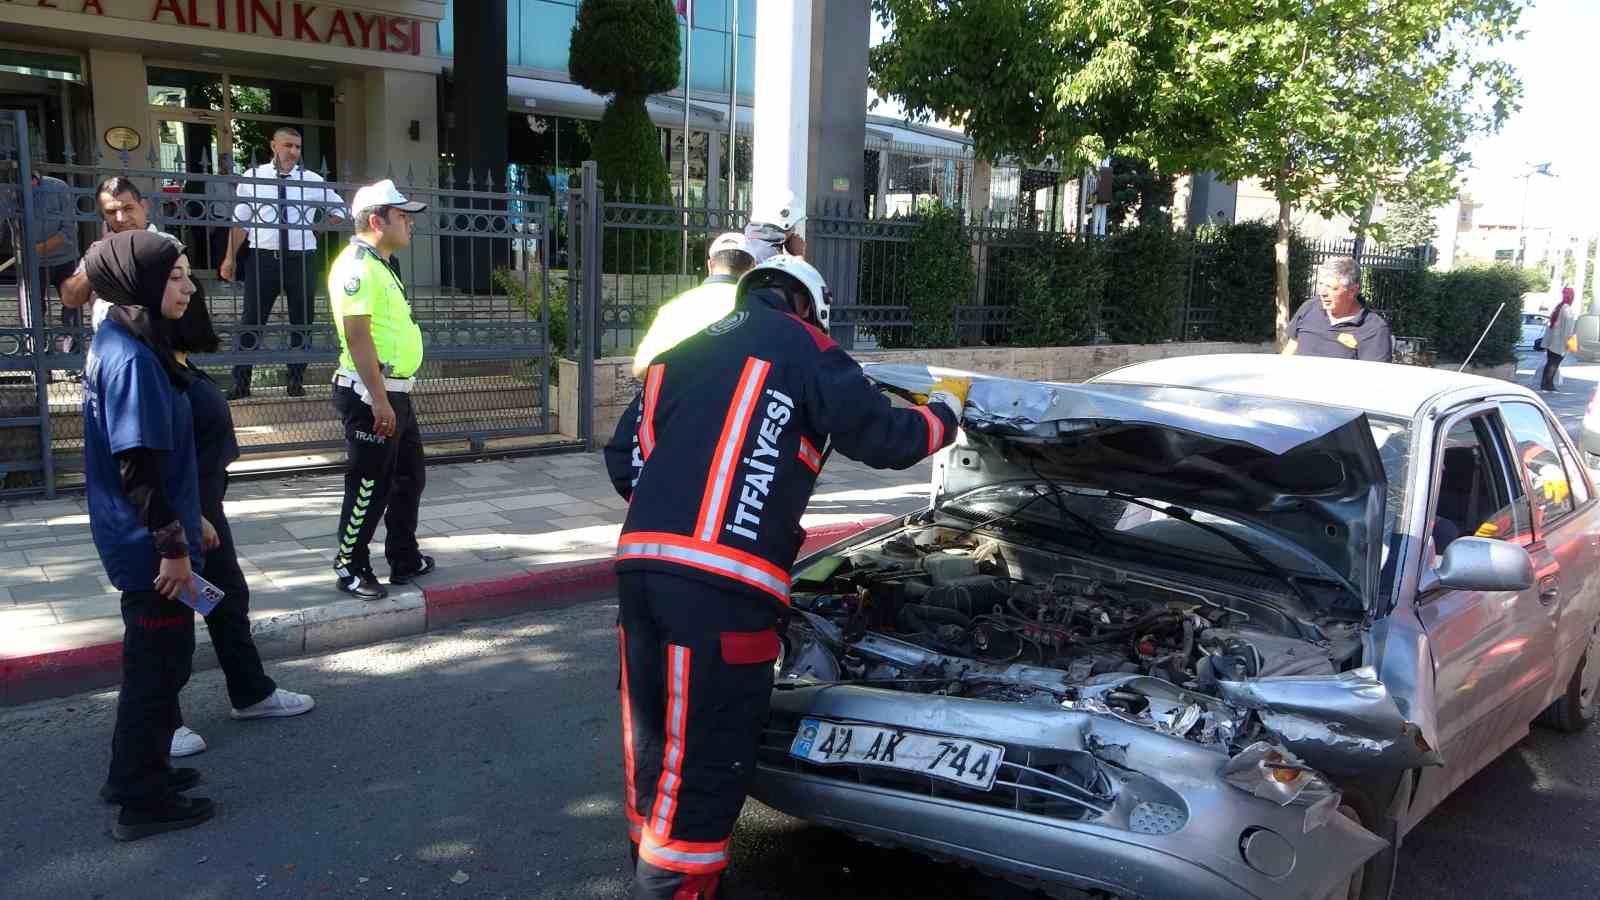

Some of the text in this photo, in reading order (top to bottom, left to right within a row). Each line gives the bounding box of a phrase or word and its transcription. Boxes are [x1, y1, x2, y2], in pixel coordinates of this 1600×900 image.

[725, 388, 795, 541] İTFAİYESİ
[818, 726, 854, 760] 44
[863, 731, 905, 762] AK
[927, 740, 993, 781] 744
